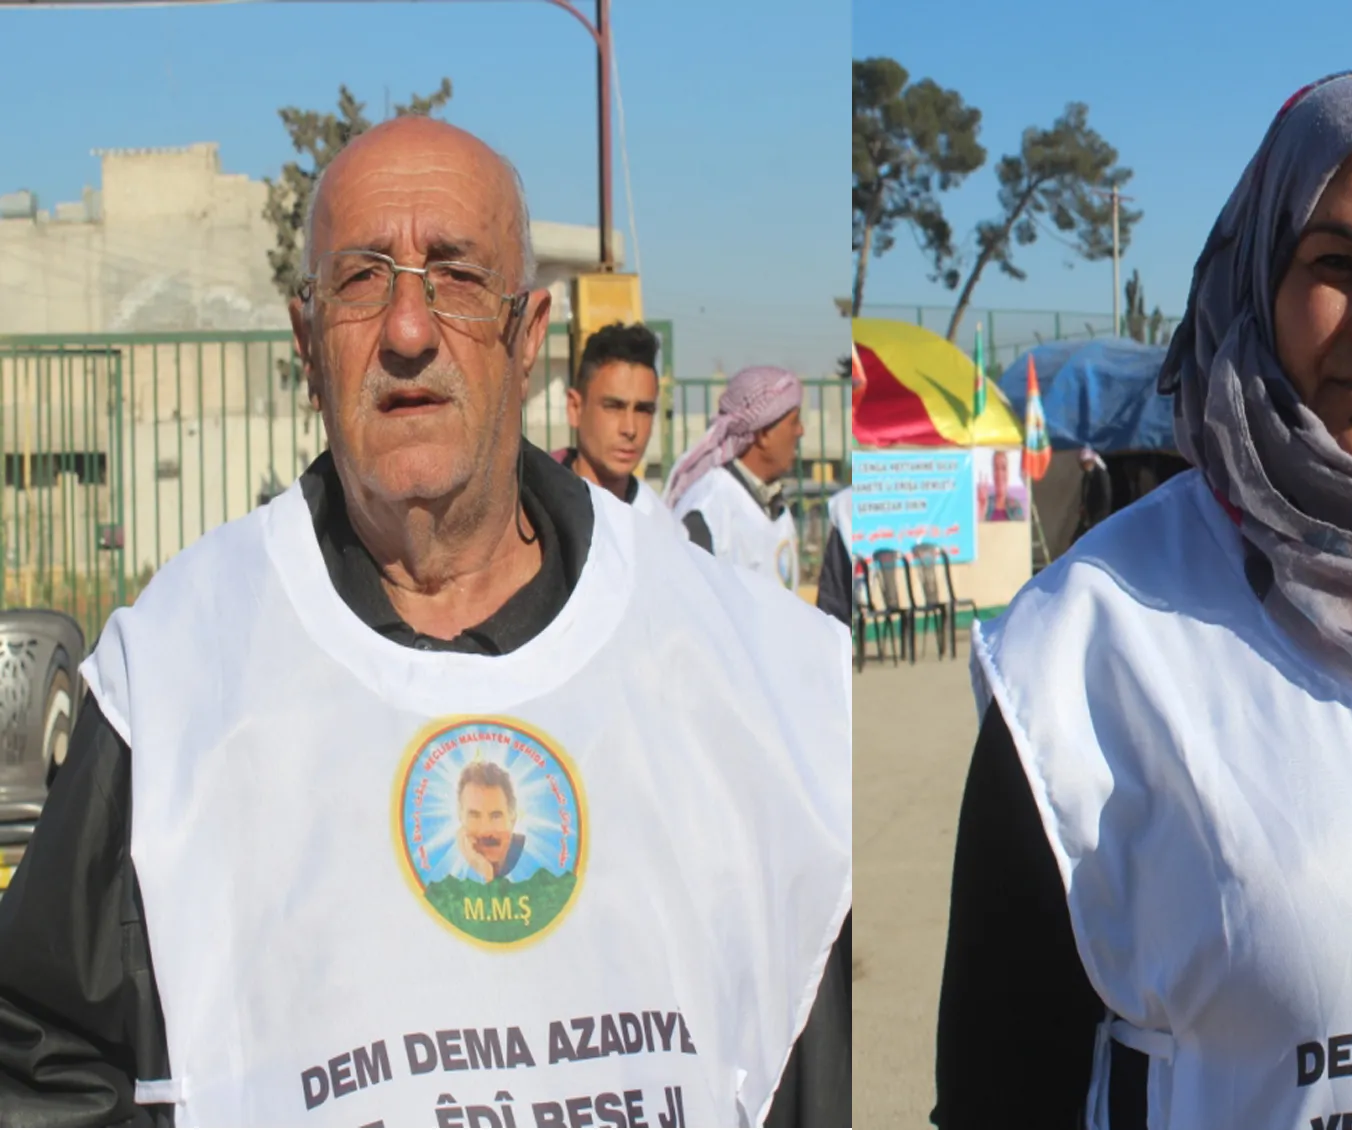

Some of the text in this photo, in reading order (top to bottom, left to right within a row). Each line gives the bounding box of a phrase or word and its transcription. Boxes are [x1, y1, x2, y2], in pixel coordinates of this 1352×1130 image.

[463, 895, 532, 926] M.M.Ş
[301, 1039, 393, 1111] DEM
[403, 1026, 536, 1075] DEMA
[658, 1086, 686, 1128] JI
